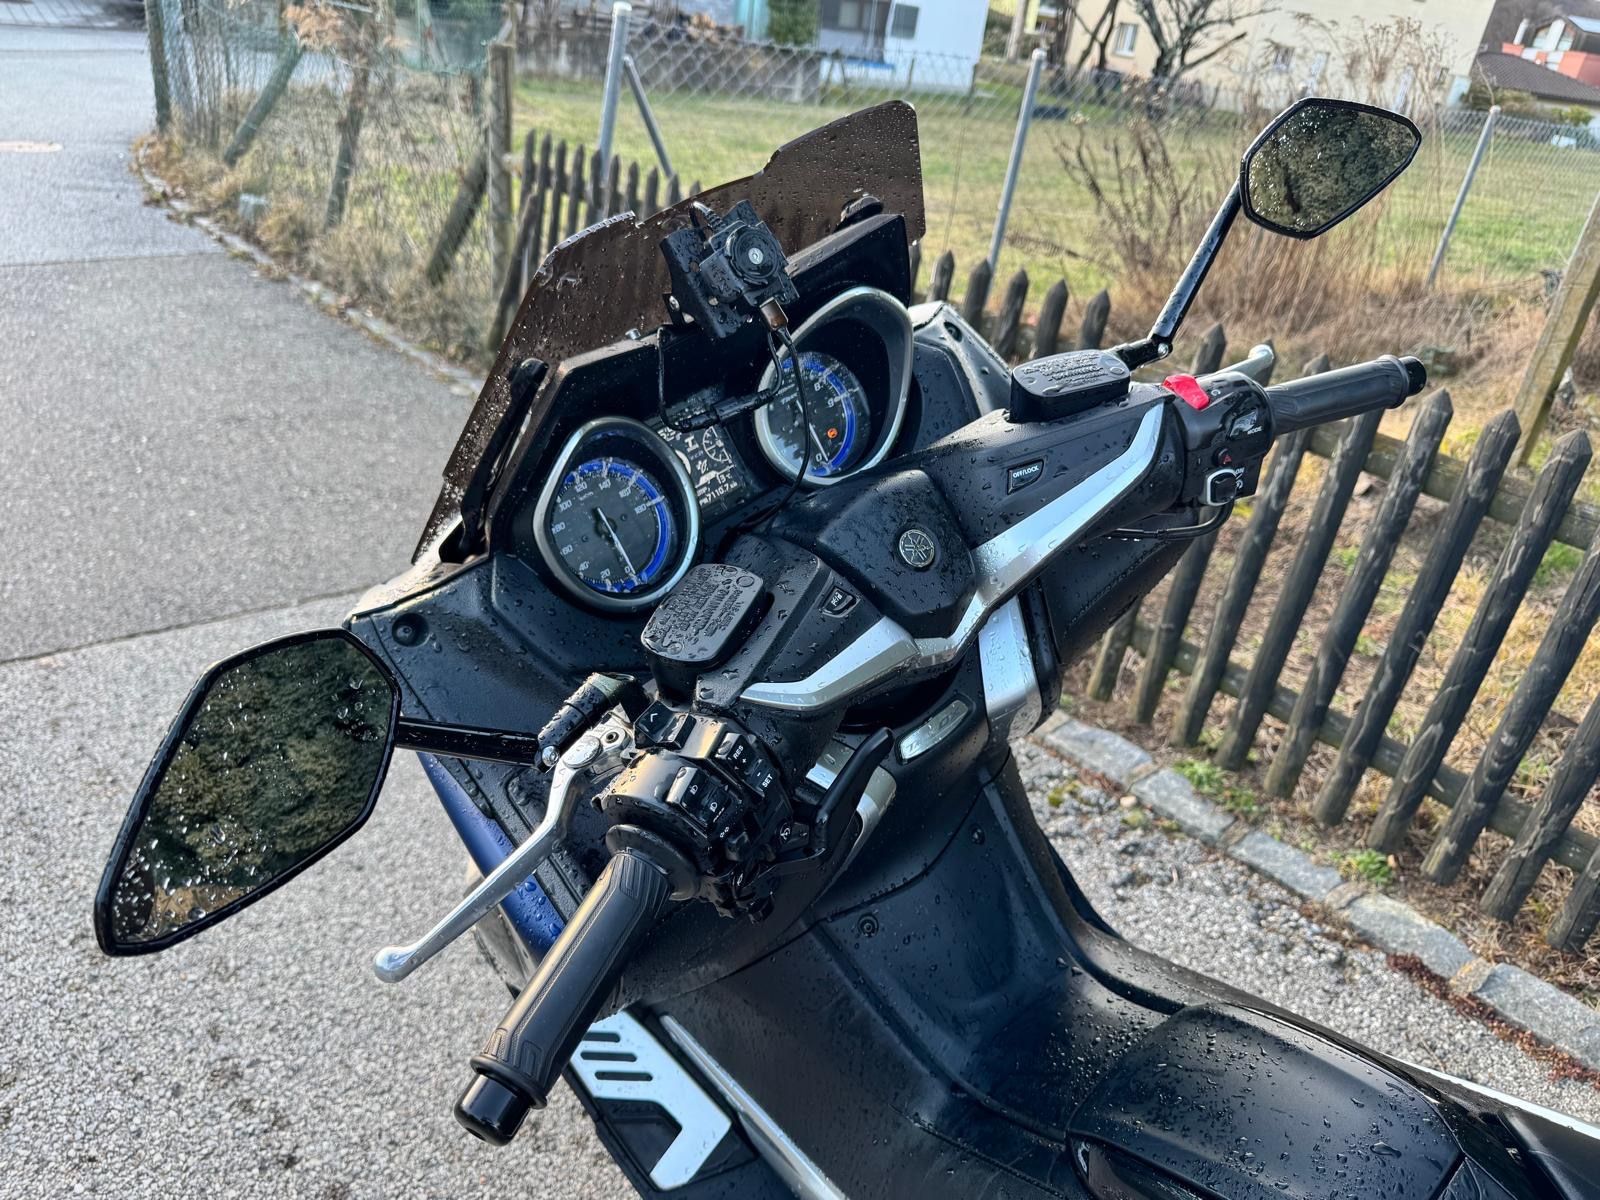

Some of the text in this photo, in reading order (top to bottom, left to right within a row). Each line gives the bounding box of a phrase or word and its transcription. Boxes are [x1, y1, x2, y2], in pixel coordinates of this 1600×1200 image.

[815, 452, 823, 463] 0
[1012, 465, 1040, 478] OFF/LOCK
[574, 482, 588, 492] 120
[598, 480, 612, 490] 140
[618, 488, 633, 499] 160
[559, 500, 573, 511] 100
[633, 504, 648, 515] 180
[578, 560, 589, 571] 40
[600, 568, 611, 579] 20
[733, 745, 744, 760] RES
[761, 773, 773, 788] SET
